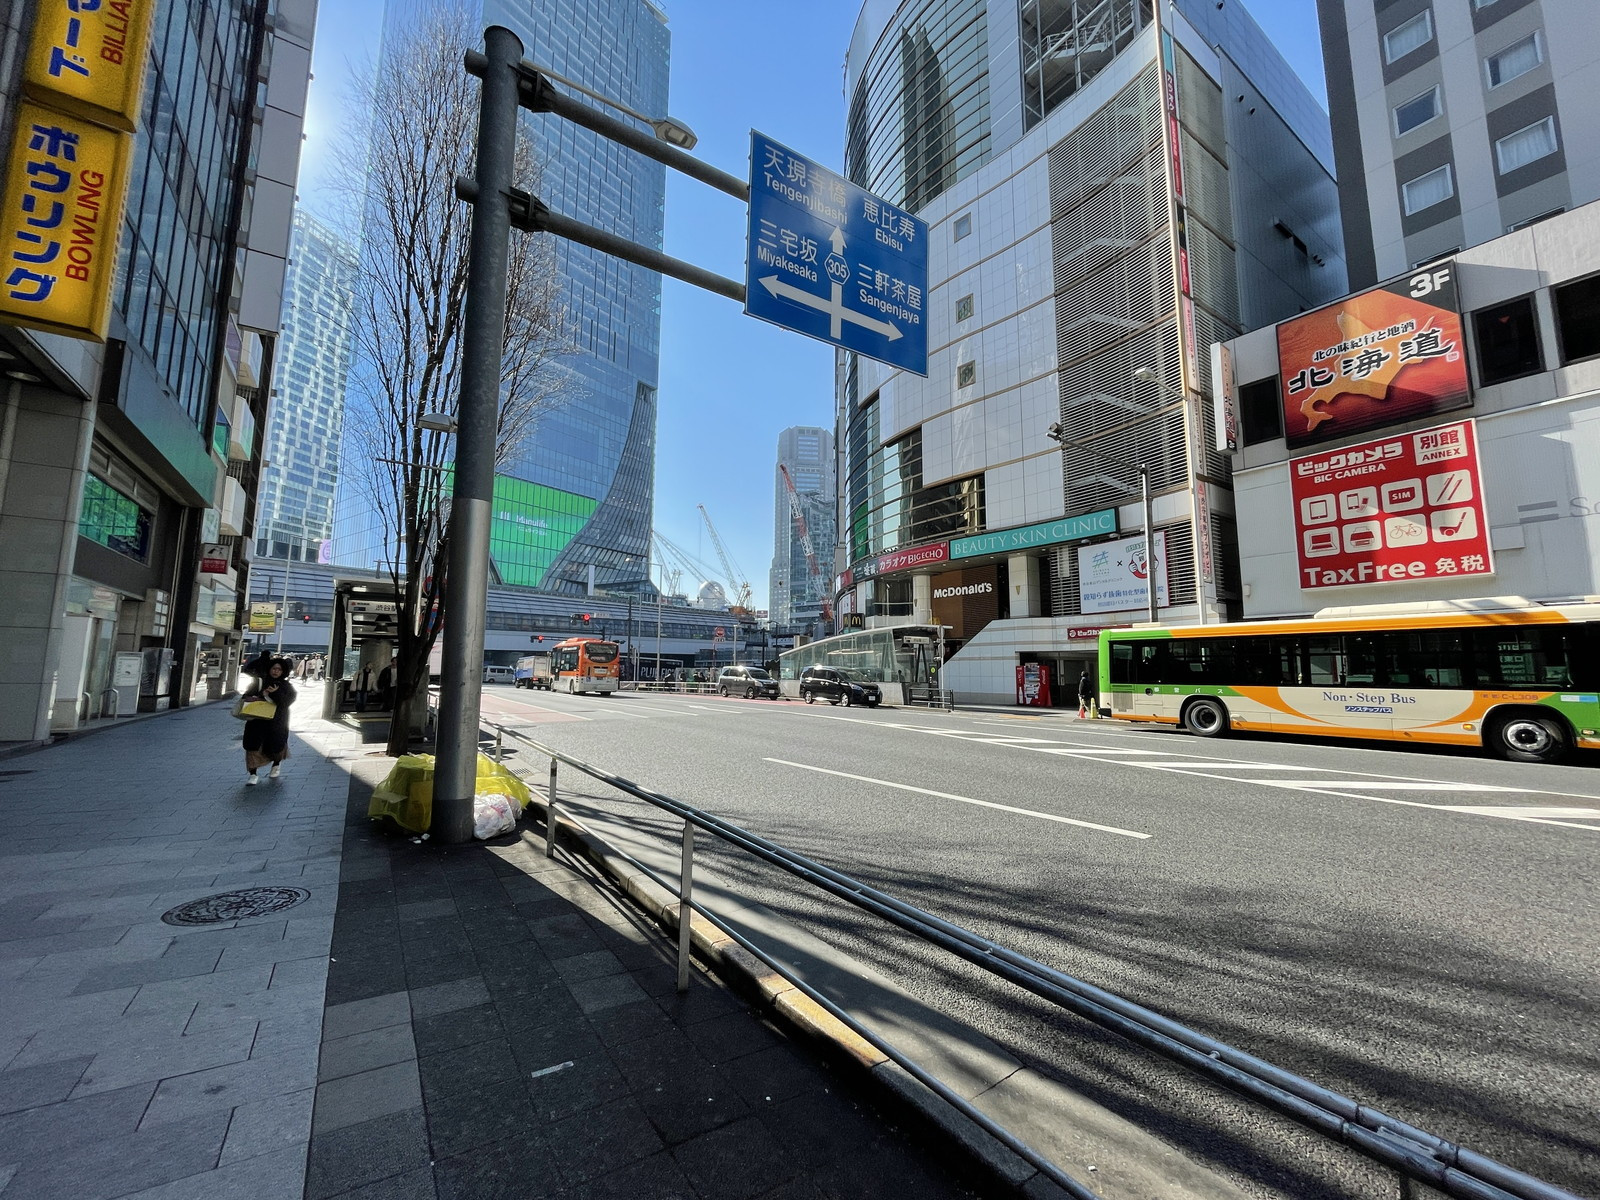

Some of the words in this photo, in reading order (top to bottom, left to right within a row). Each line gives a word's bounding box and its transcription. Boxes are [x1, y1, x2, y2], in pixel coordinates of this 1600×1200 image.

[763, 144, 847, 208] 天現寺橋
[6, 124, 80, 303] ボウリング
[764, 171, 848, 225] Tengenjibashi
[65, 169, 104, 281] BOWLING
[862, 197, 915, 243] 恵比寿
[759, 218, 818, 266] 三宅坂
[875, 229, 903, 252] Ebisu
[757, 245, 818, 282] Miyakesaka
[827, 257, 847, 279] 305
[857, 263, 922, 311] 三軒茶屋
[1409, 268, 1450, 298] 3F
[859, 289, 920, 325] Sangenjaya
[1313, 320, 1415, 361] 北の味紀行と地酒
[1288, 328, 1455, 394] 北海道
[1420, 429, 1459, 450] 別館
[1422, 448, 1461, 462] ANNEX
[1298, 442, 1403, 476] ビックカメラ
[1314, 472, 1333, 484] BIC
[1335, 463, 1386, 479] CAMERA
[1391, 491, 1411, 501] SIM
[955, 535, 1008, 555] BEAUTY
[1012, 528, 1047, 545] SKIN
[1052, 514, 1112, 538] CLINIC
[879, 555, 907, 571] カラオケ
[908, 554, 921, 564] BIG
[921, 549, 943, 559] ECHO
[933, 582, 993, 599] McDonald's
[1390, 693, 1416, 704] Bus
